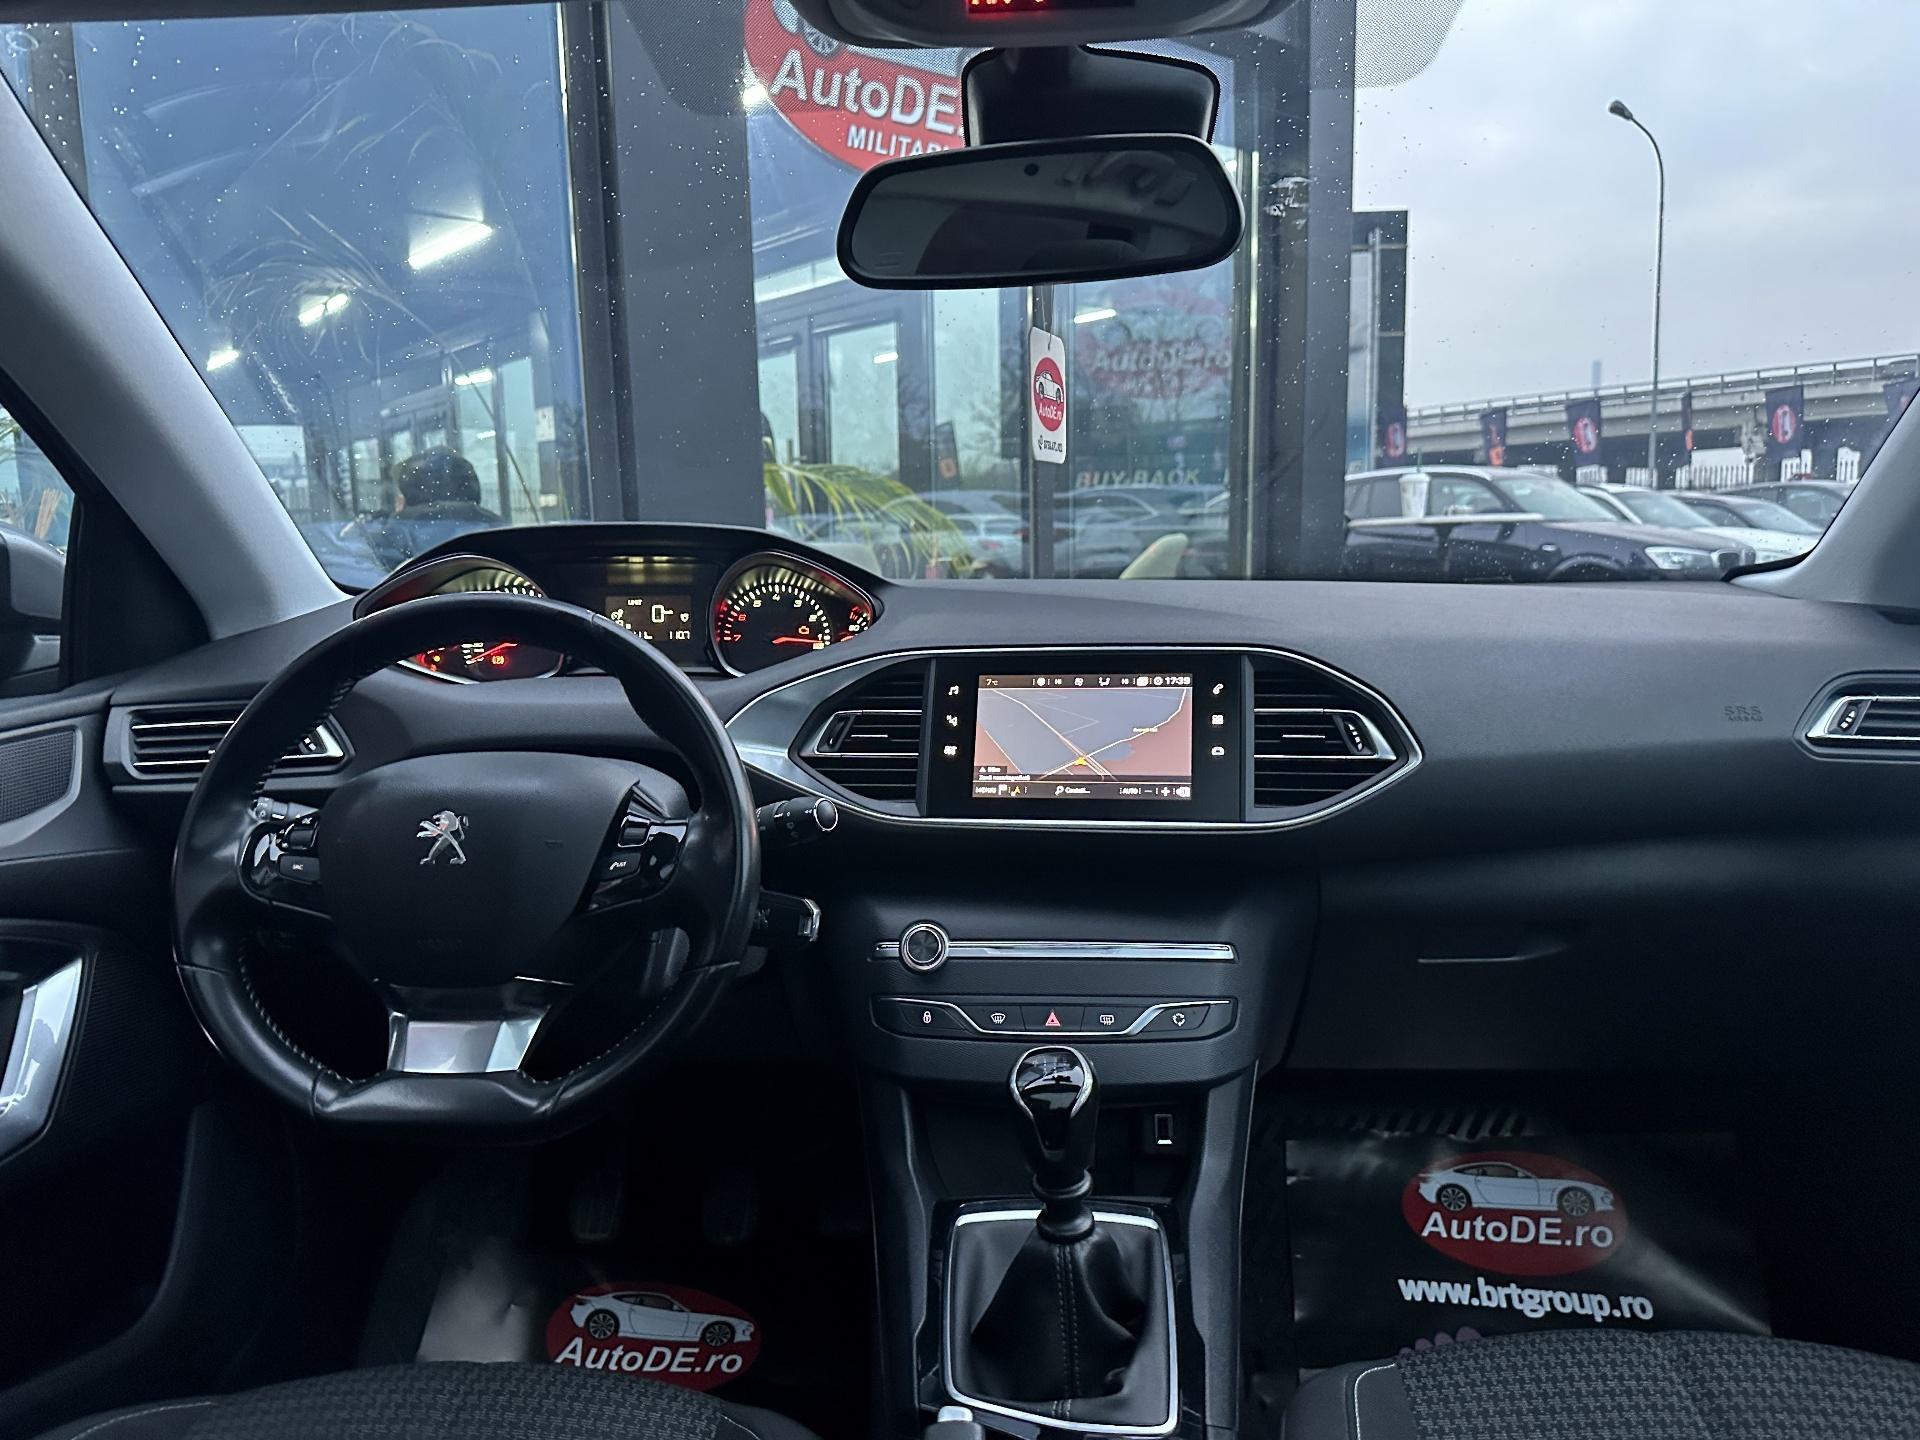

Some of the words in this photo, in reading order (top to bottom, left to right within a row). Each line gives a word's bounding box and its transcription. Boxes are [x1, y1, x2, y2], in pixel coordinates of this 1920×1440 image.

[1420, 1211, 1614, 1249] AutoDE.ro
[1398, 1277, 1654, 1323] www.brtgroup.ro
[555, 1336, 743, 1374] AutoDE.ro
